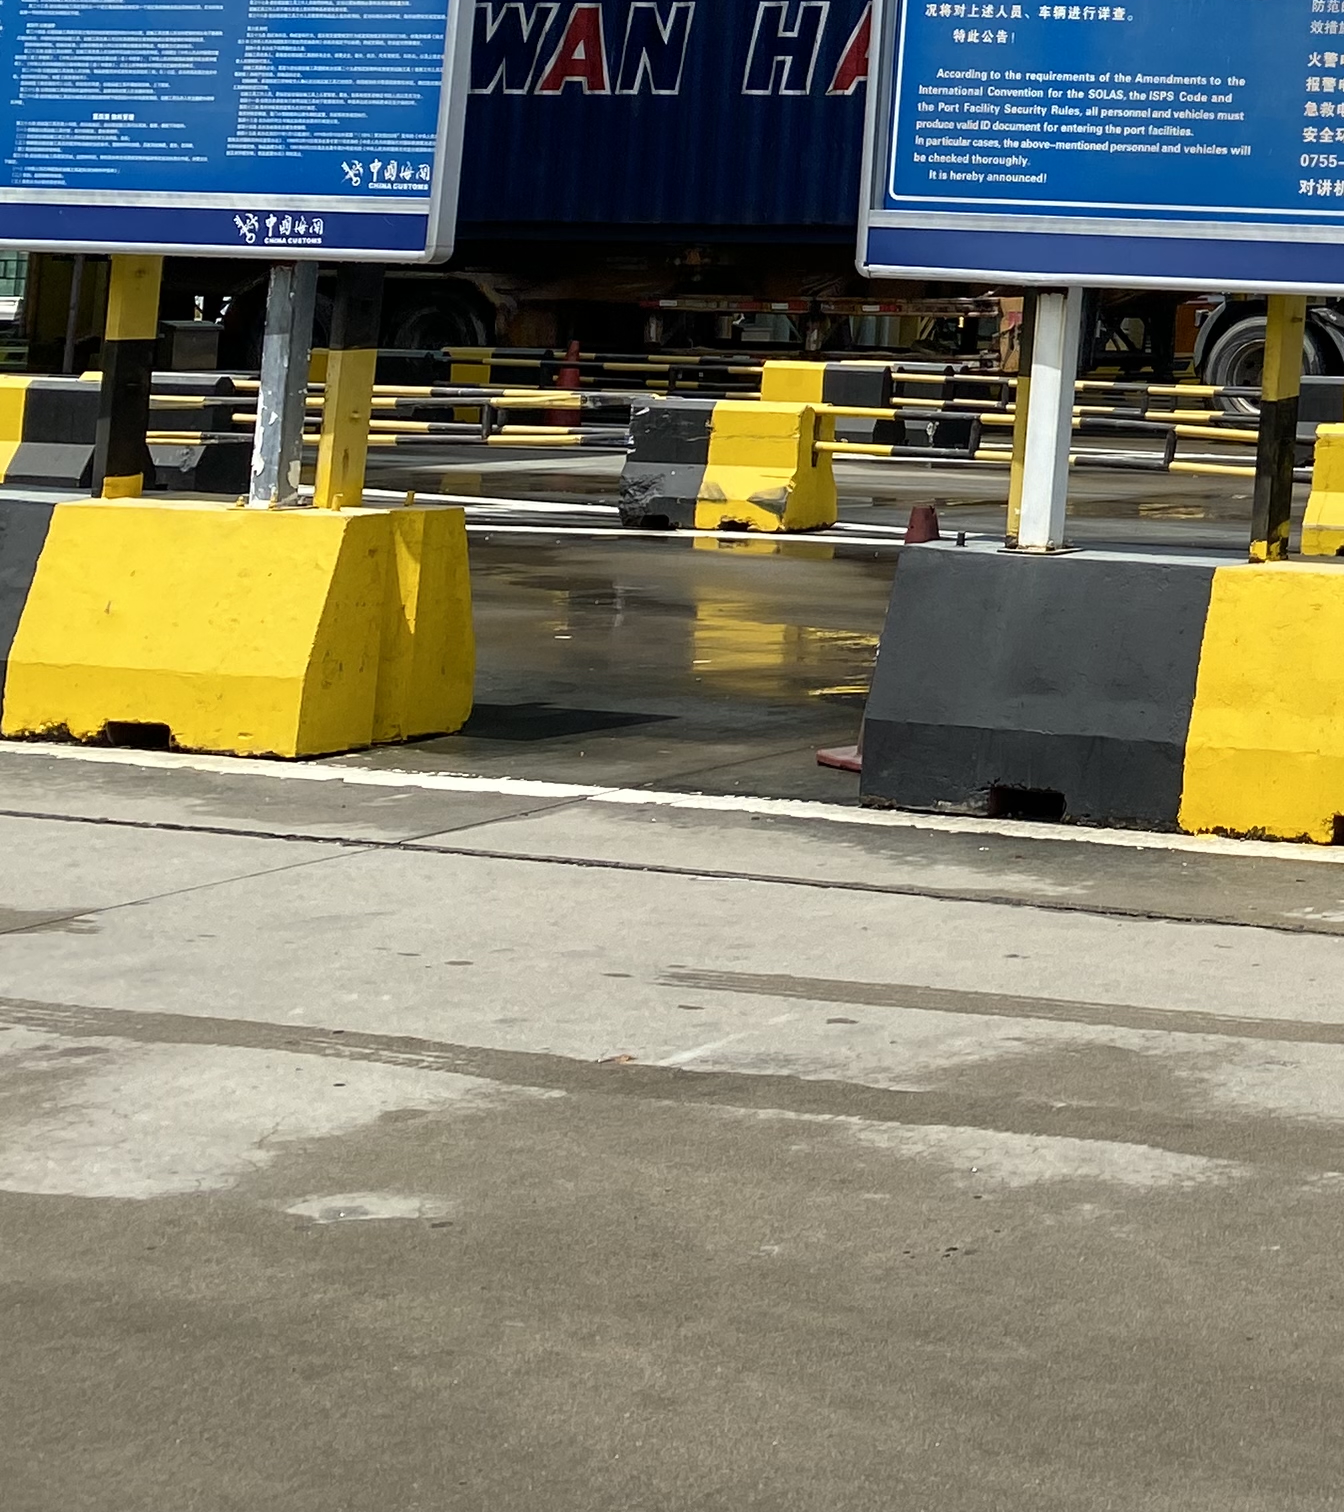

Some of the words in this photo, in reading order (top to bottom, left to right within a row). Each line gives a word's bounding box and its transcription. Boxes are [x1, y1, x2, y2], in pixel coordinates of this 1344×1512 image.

[466, 2, 696, 96] WAN
[937, 69, 987, 82] According
[990, 70, 1000, 80] to
[1005, 70, 1021, 80] the
[1026, 71, 1095, 85] requirements
[1100, 73, 1110, 83] of
[1114, 73, 1131, 83] the
[1135, 74, 1206, 85] Amendments
[1210, 76, 1221, 85] to
[1228, 76, 1245, 86] the
[919, 85, 983, 96] International
[988, 87, 1043, 98] Convention
[1048, 89, 1062, 98] for
[1067, 89, 1083, 99] the
[1129, 91, 1146, 101] the
[1149, 91, 1174, 101] ISPS
[1180, 92, 1207, 102] Code
[1211, 93, 1232, 103] and
[918, 102, 934, 112] the
[938, 103, 959, 113] Port
[964, 104, 999, 117] Facility
[1004, 105, 1047, 118] Security
[1086, 107, 1098, 117] all
[1101, 107, 1151, 121] personnel
[1152, 109, 1170, 119] and
[1173, 109, 1214, 120] vehicles
[1217, 110, 1244, 120] must
[916, 120, 954, 133] produce
[956, 121, 978, 131] valid
[981, 121, 990, 131] ID
[993, 121, 1040, 132] document
[1044, 123, 1058, 133] for
[1061, 123, 1103, 136] entering
[1105, 124, 1121, 134] the
[1124, 125, 1145, 137] port
[915, 136, 924, 146] In
[926, 137, 971, 150] particular
[1003, 139, 1018, 149] the
[1111, 142, 1160, 156] personnel
[1162, 144, 1180, 154] and
[1184, 145, 1227, 155] vehicles
[1230, 146, 1251, 156] will
[914, 153, 926, 163] be
[929, 153, 969, 164] checked
[929, 170, 937, 179] It
[939, 170, 947, 180] is
[950, 171, 984, 184] hereby
